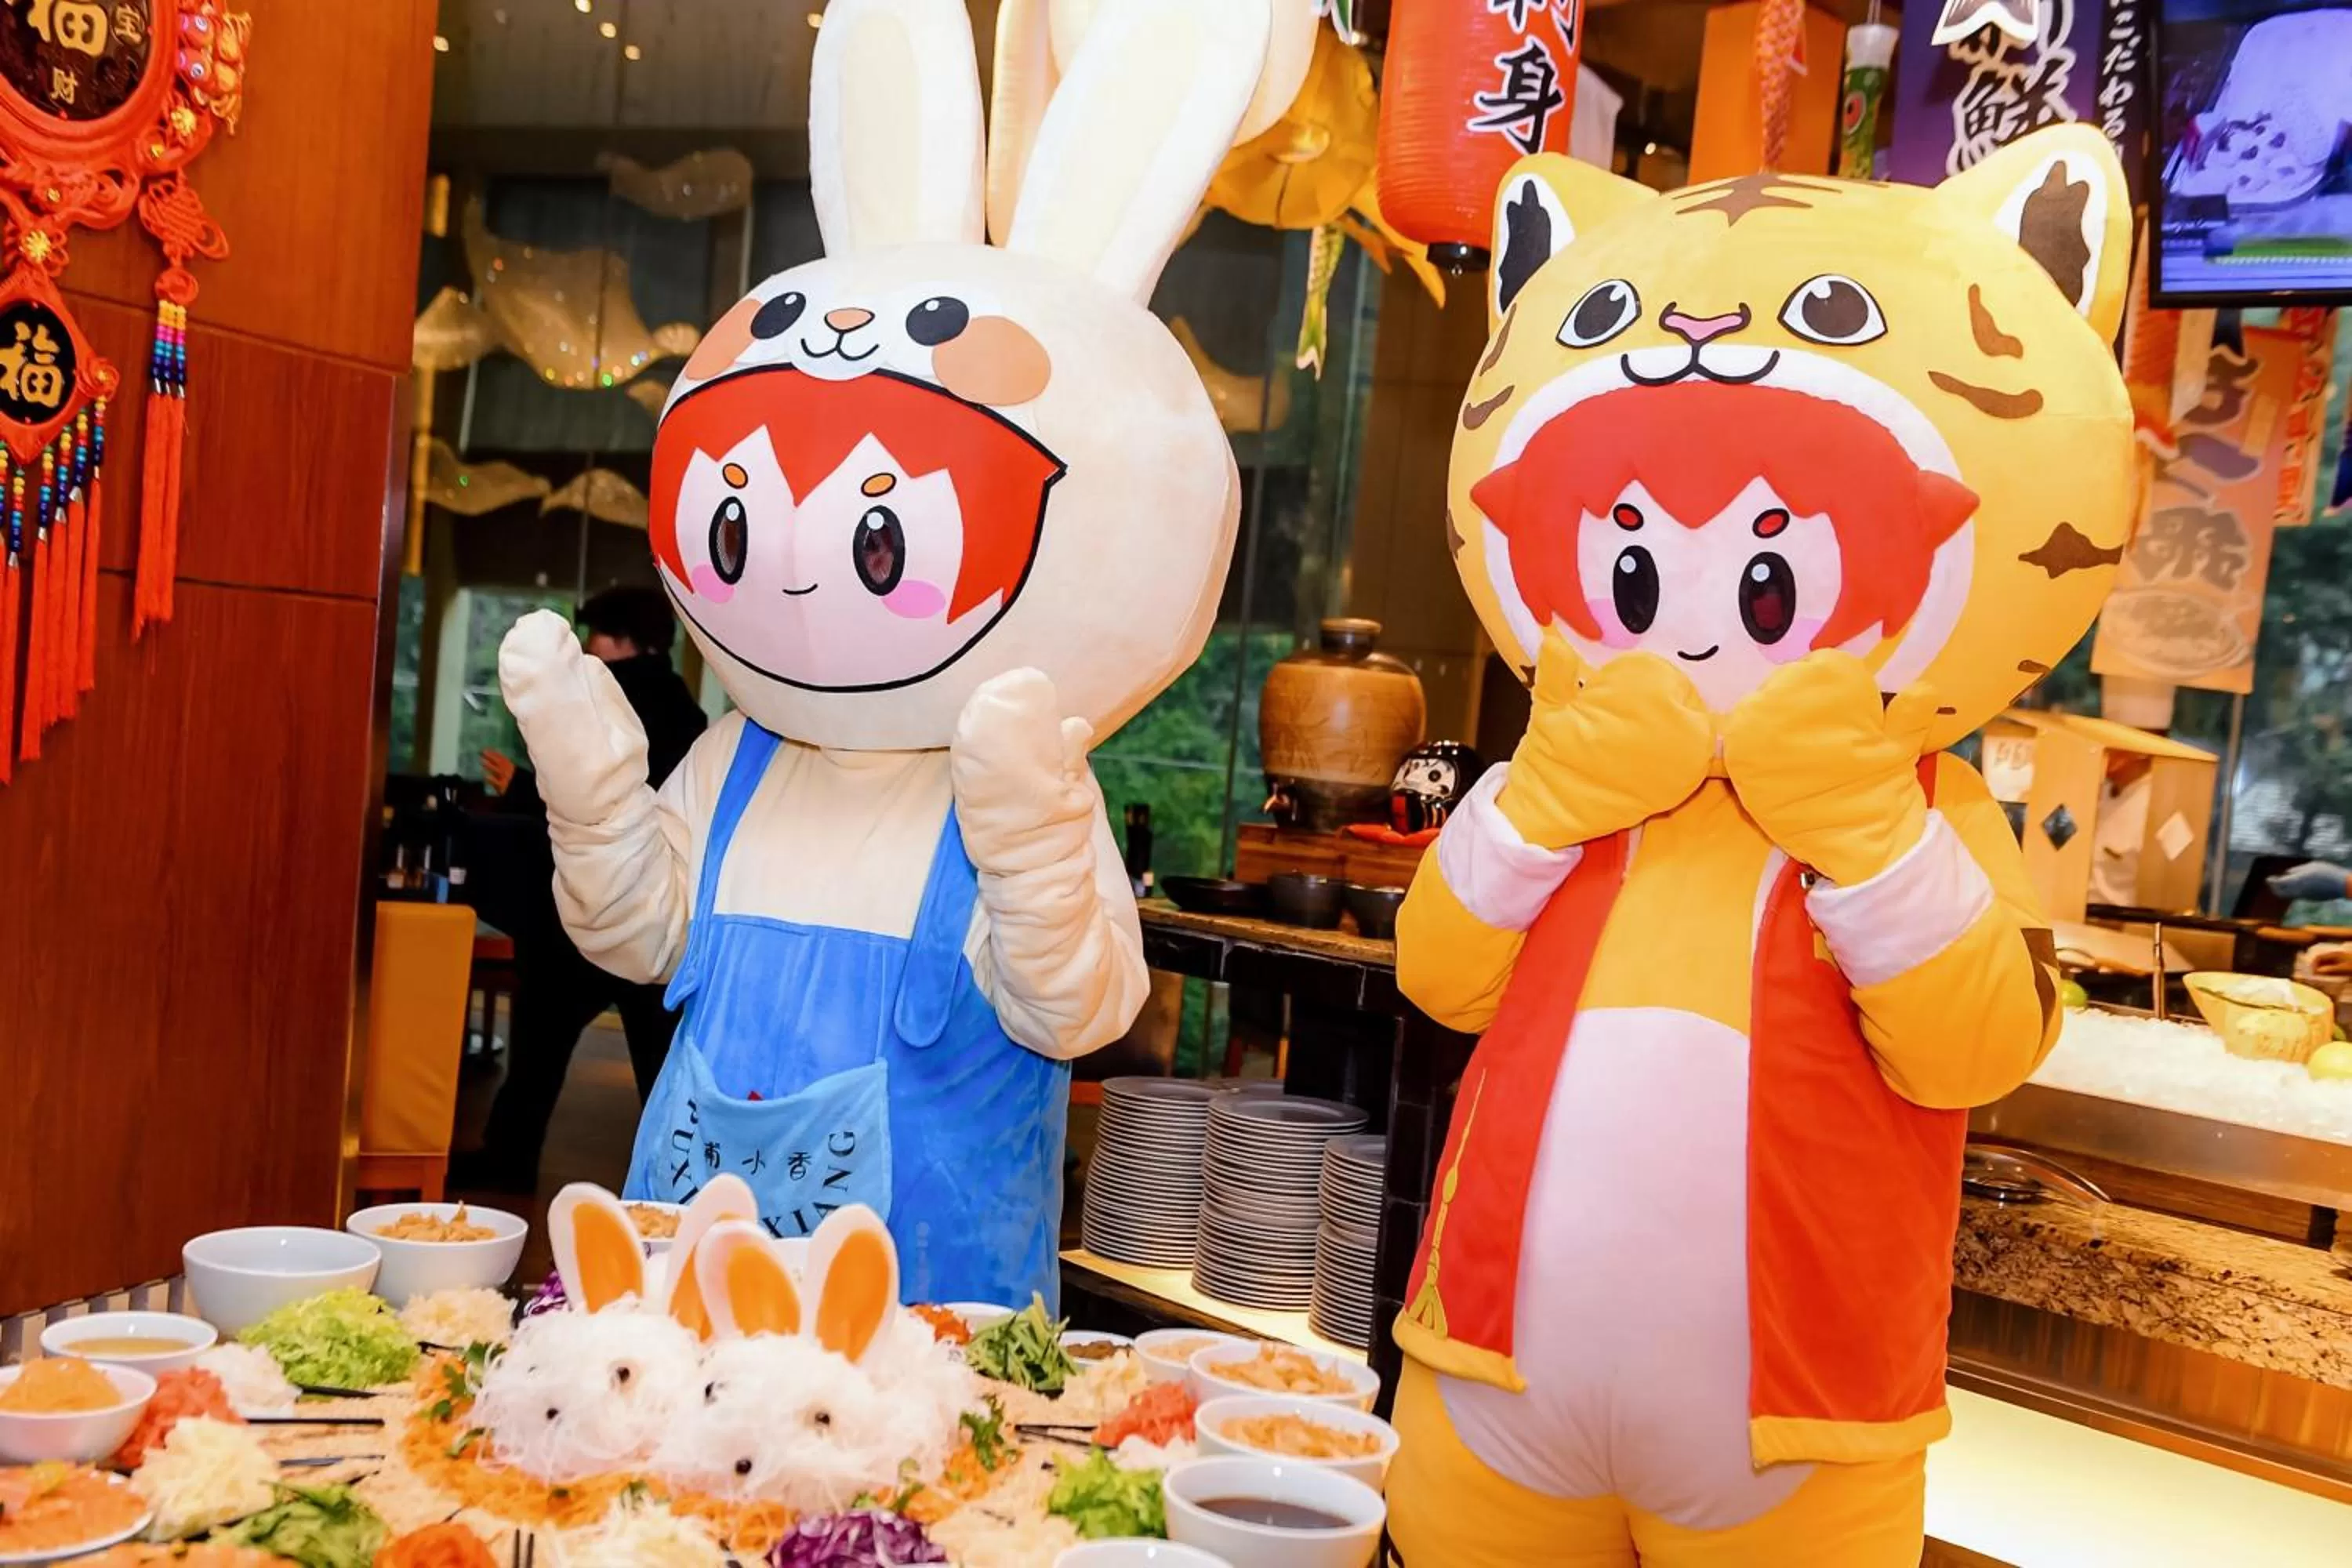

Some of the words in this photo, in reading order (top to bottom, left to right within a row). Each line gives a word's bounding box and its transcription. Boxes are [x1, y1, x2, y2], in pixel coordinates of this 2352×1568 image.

[2099, 0, 2142, 161] こだわる
[0, 321, 63, 408] 福
